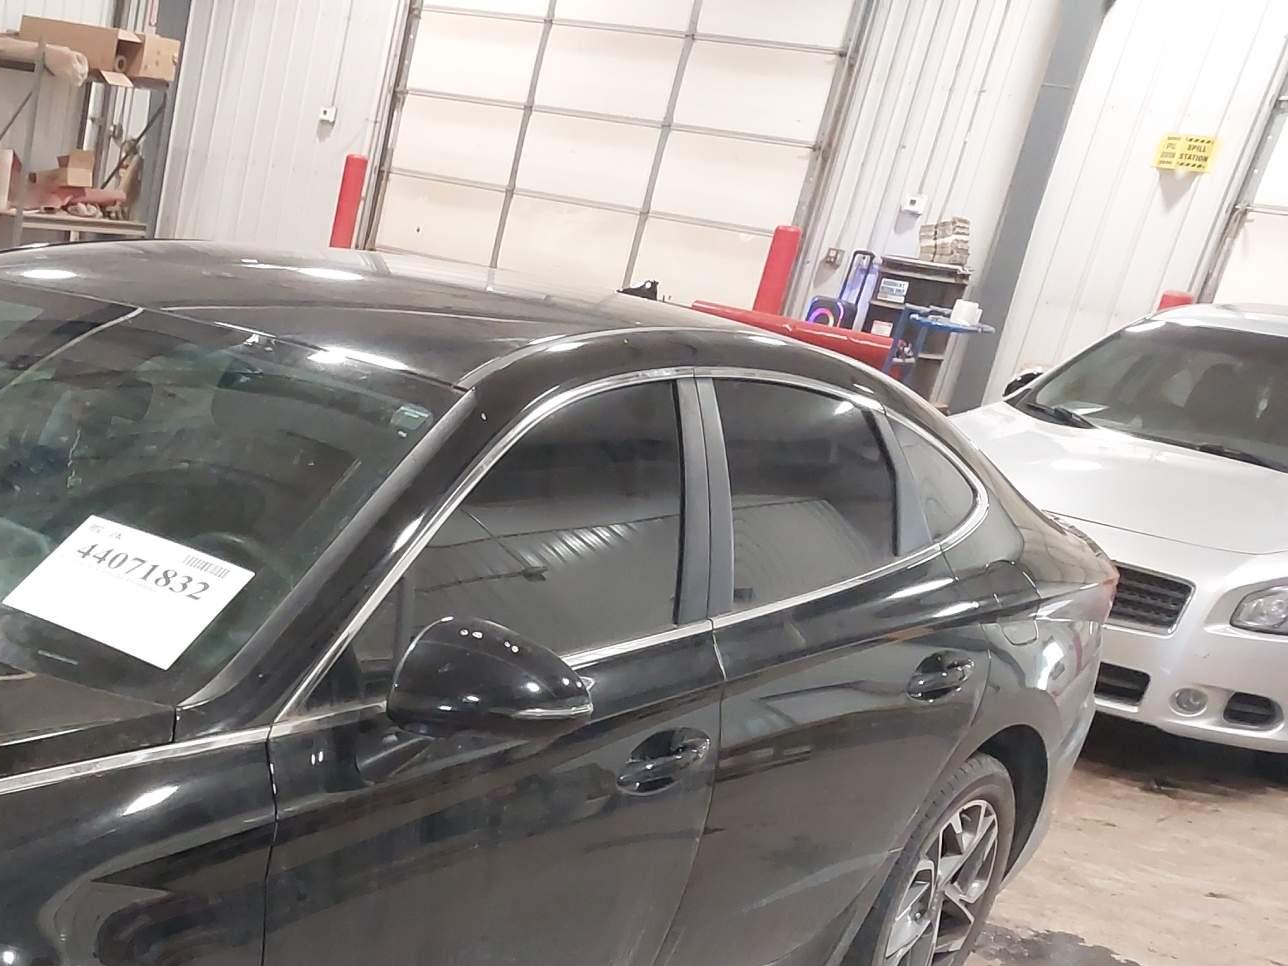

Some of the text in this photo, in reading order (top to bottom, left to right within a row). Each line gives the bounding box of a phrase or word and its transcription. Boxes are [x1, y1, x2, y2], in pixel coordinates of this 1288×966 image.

[1187, 144, 1207, 152] SPILL
[1179, 153, 1208, 162] STATION
[77, 544, 210, 600] 44071832
